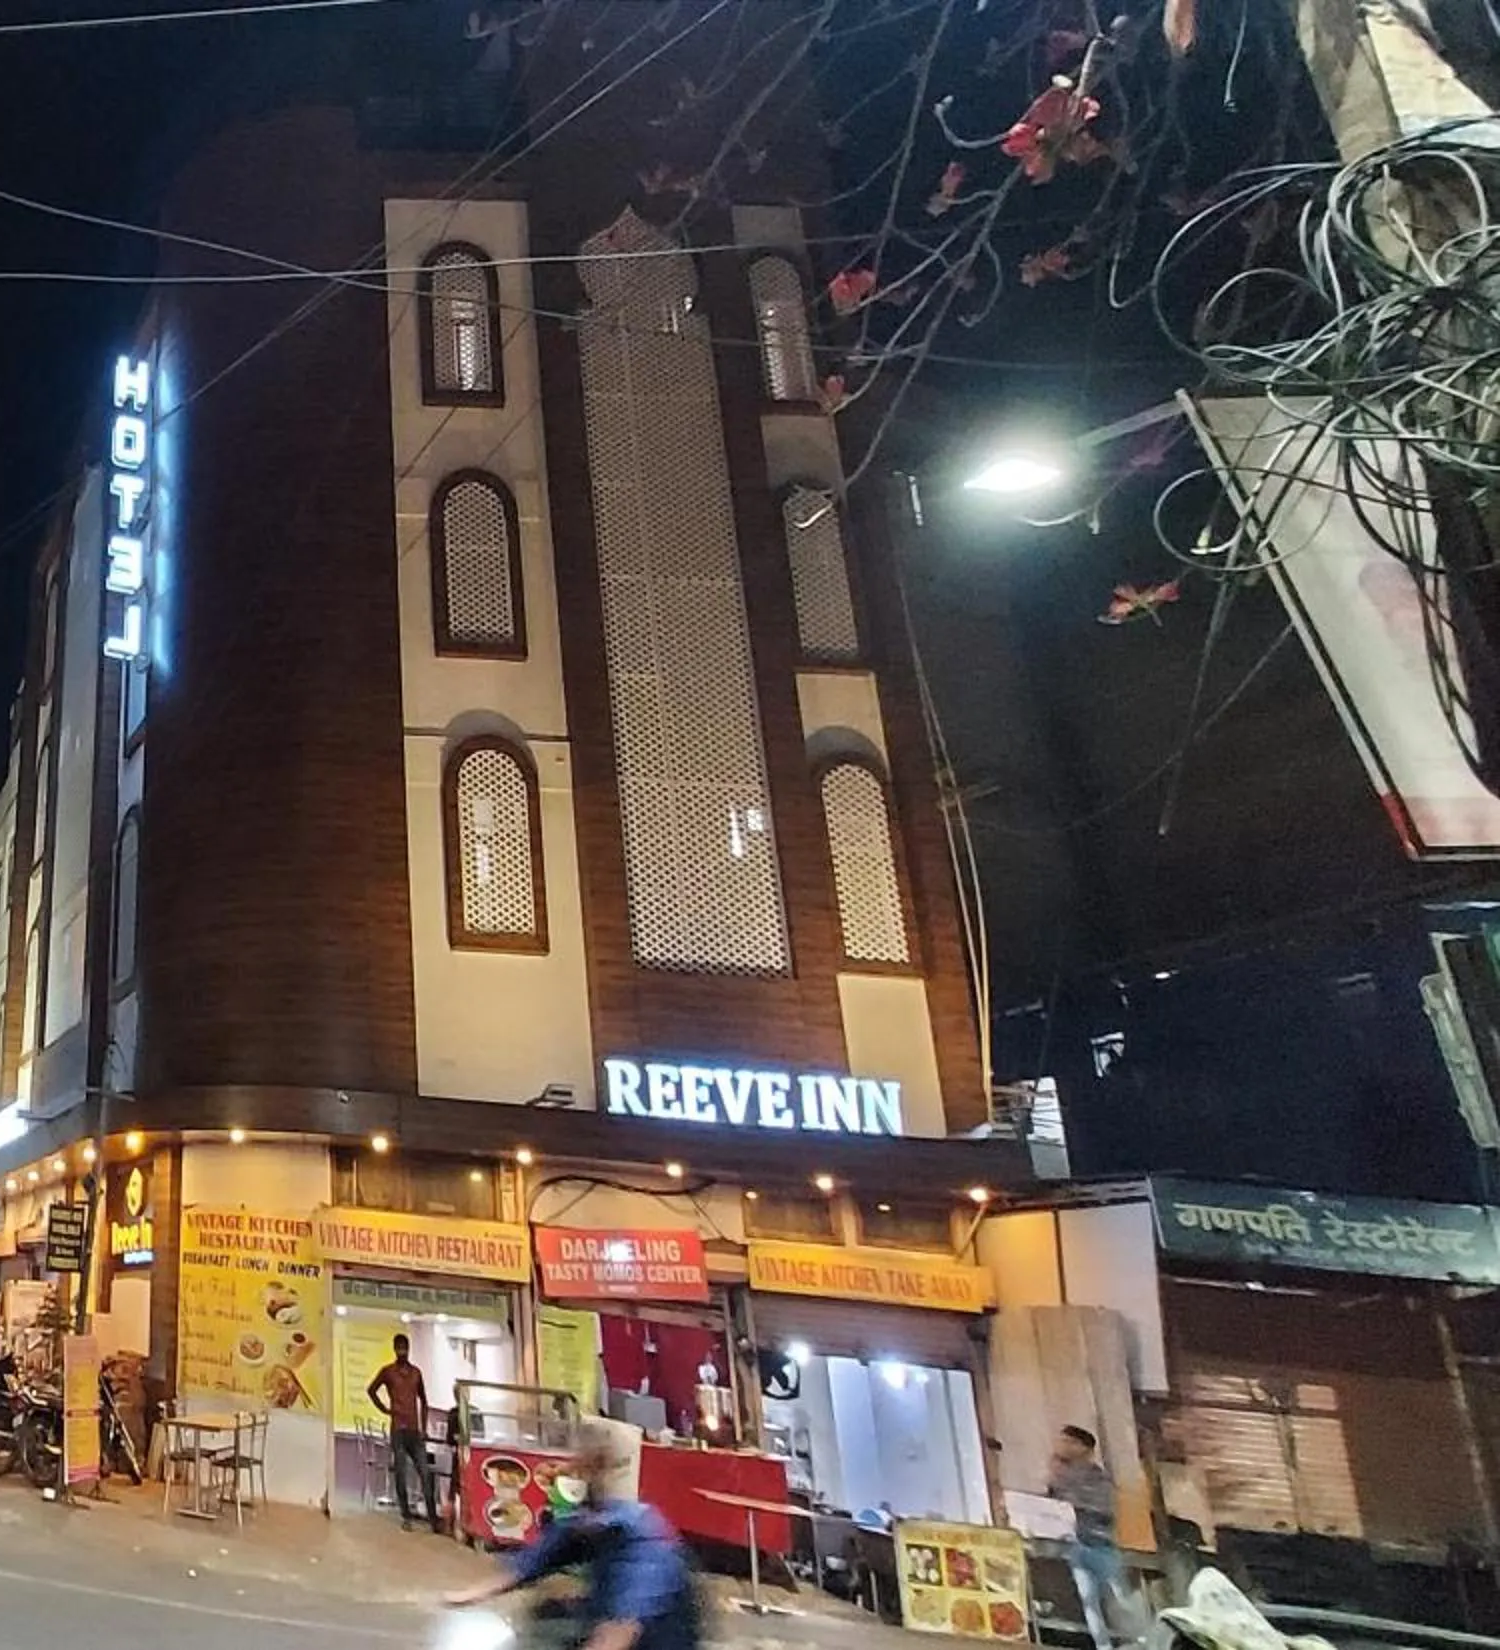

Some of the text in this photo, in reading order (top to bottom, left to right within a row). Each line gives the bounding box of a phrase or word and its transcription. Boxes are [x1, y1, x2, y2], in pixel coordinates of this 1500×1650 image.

[603, 1059, 902, 1136] REEVE INN
[187, 1213, 313, 1237] VINTAGE KITCHEN
[1173, 1203, 1313, 1243] गणपति
[199, 1231, 298, 1255] RESTAURANT
[319, 1223, 373, 1252] VINTAGE
[378, 1231, 434, 1258] KITCHEN
[437, 1236, 524, 1269] RESTAURANT
[560, 1238, 682, 1263] DARJELING
[278, 1261, 321, 1279] DINNER
[546, 1263, 703, 1283] TASTY MOMOS CENTER
[754, 1255, 974, 1300] VINTAGE KITCHEN TAKE AWAY
